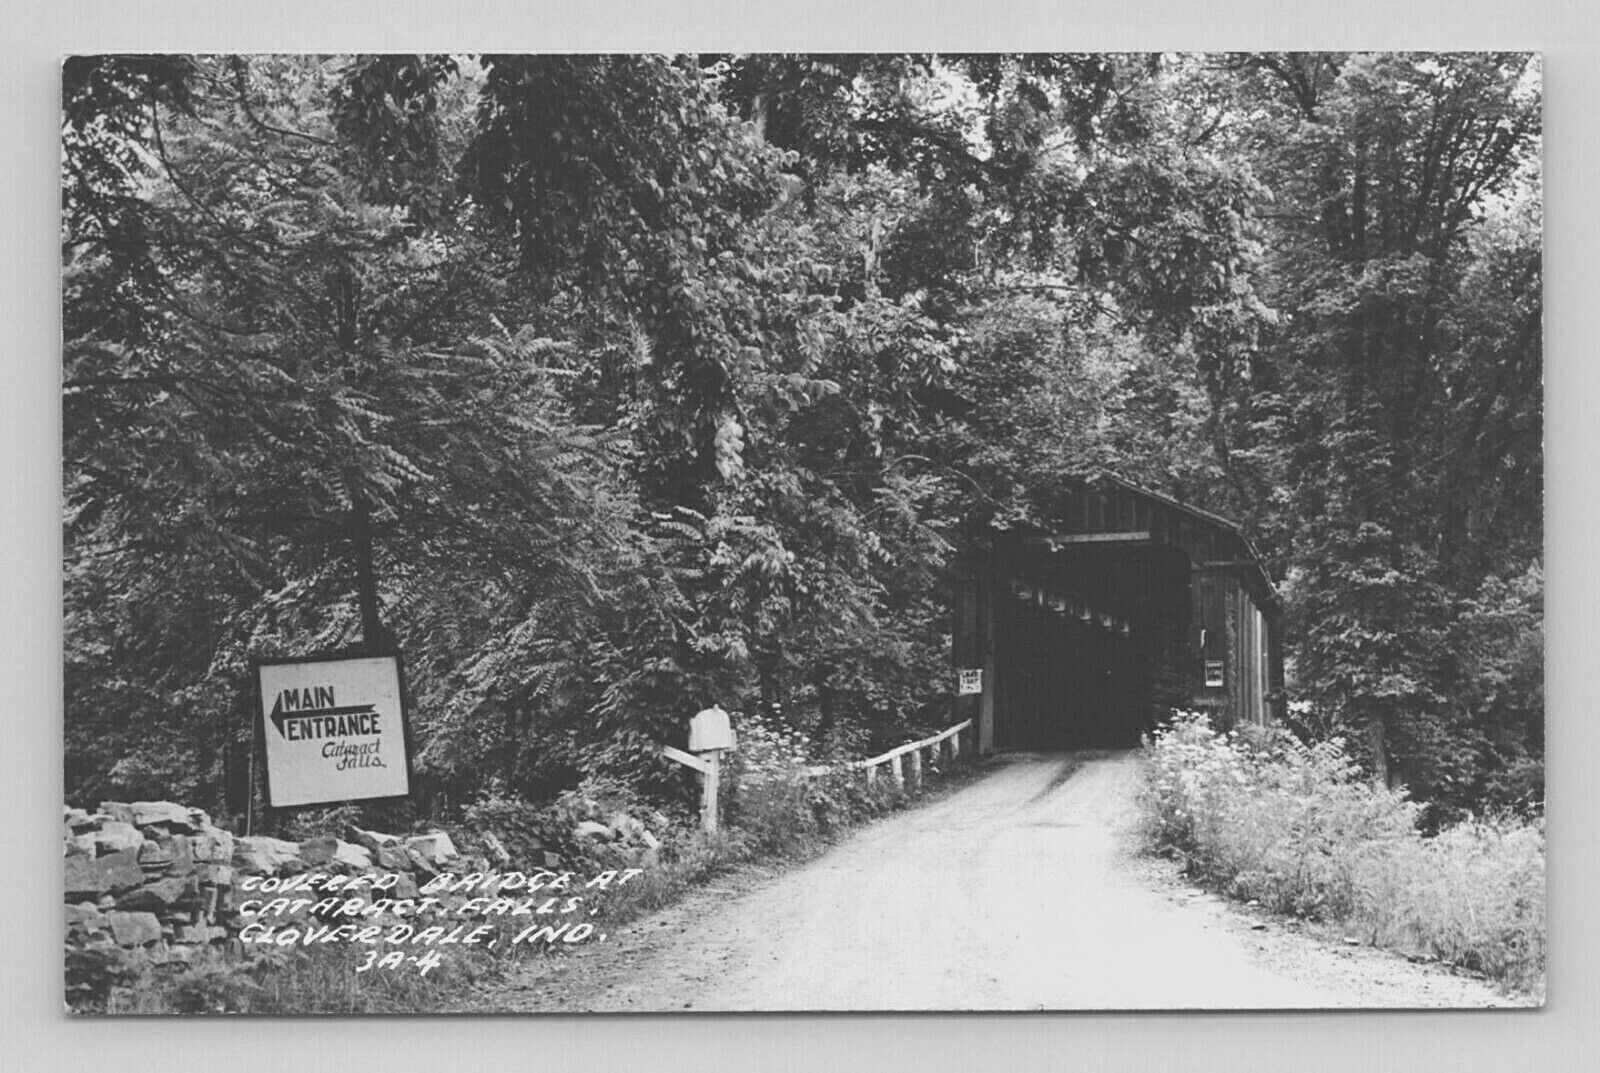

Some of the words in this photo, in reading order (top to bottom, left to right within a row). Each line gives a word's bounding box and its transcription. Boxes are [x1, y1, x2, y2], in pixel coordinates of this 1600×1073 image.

[283, 686, 335, 710] MAIN
[287, 713, 382, 741] ENTRANCE
[322, 738, 380, 758] Cataract
